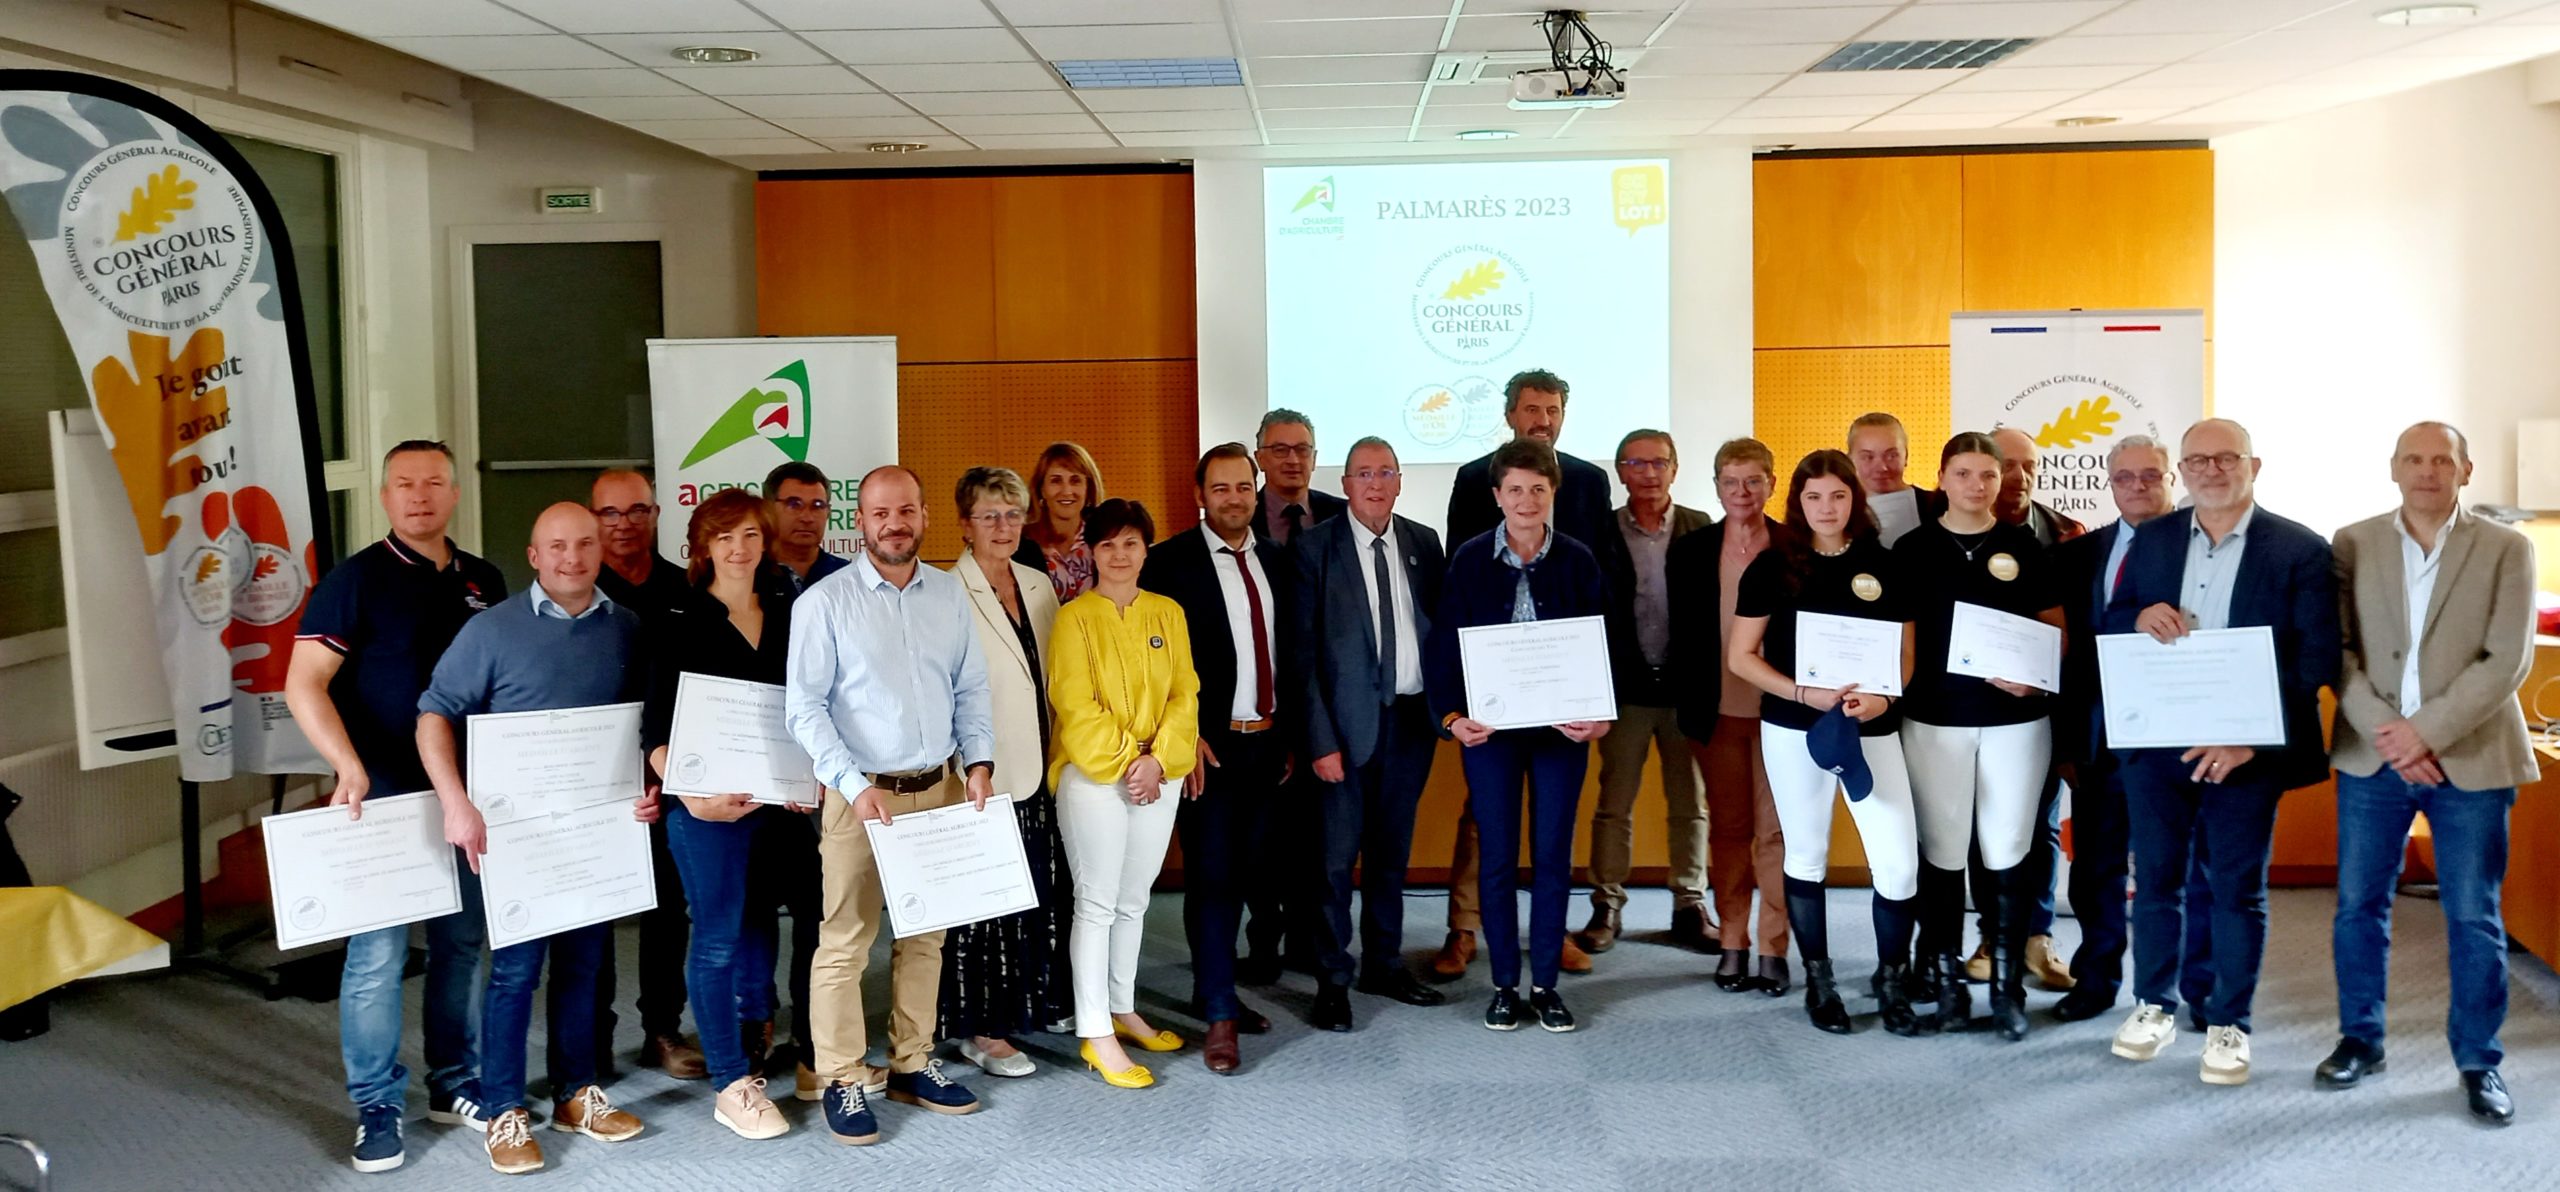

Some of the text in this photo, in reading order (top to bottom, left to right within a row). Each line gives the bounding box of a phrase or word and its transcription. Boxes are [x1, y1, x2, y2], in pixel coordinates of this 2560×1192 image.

[67, 146, 217, 212] CONCOURS GÉNÉRAL AGRICOLE
[547, 195, 589, 207] SORTIE
[1376, 195, 1571, 220] PALMARÈS 2023
[1619, 205, 1652, 220] LOT
[226, 184, 255, 254] ALIMENTAIRE
[93, 224, 236, 276] CONCOURS
[117, 249, 227, 293] GÉNÉRAL
[161, 281, 201, 306] PARIS
[1423, 304, 1523, 318] CONCOURS
[1432, 317, 1514, 333] GÉNÉRAL
[1457, 335, 1489, 349] PARIS
[2005, 380, 2052, 411] CONCOURS
[2100, 379, 2144, 411] AGRICOLE
[2053, 494, 2097, 513] PARIS
